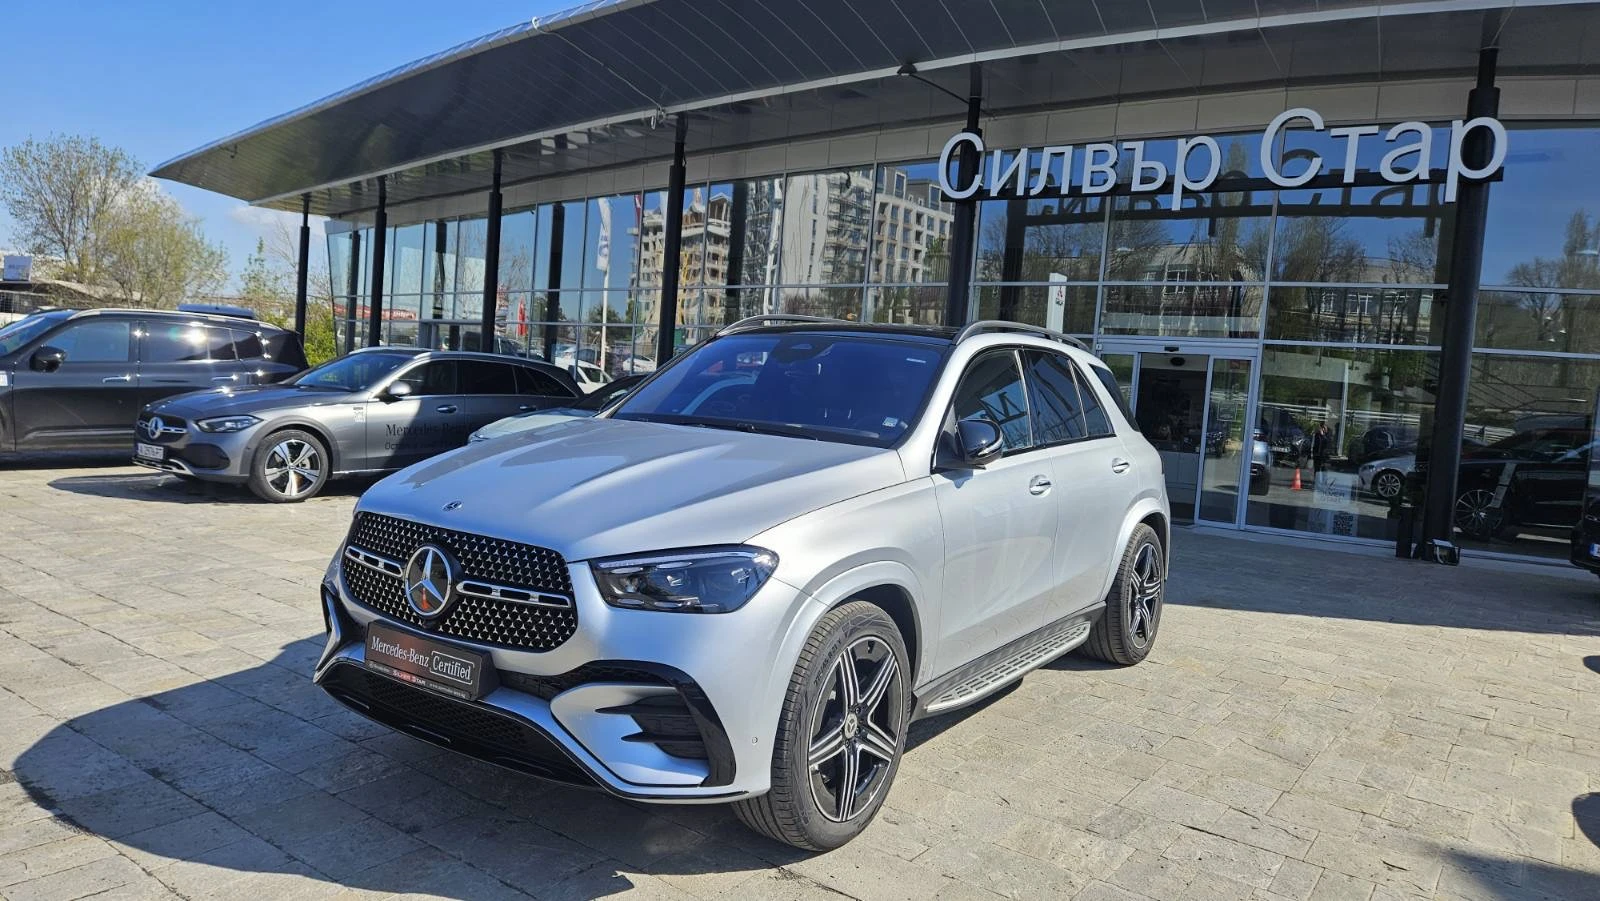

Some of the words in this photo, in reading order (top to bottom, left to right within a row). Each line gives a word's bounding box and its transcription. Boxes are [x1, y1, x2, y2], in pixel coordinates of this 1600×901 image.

[938, 132, 1221, 211] Силвър
[1260, 108, 1508, 203] Стар
[371, 635, 429, 668] Mercedes-Benz
[432, 655, 471, 680] Certified
